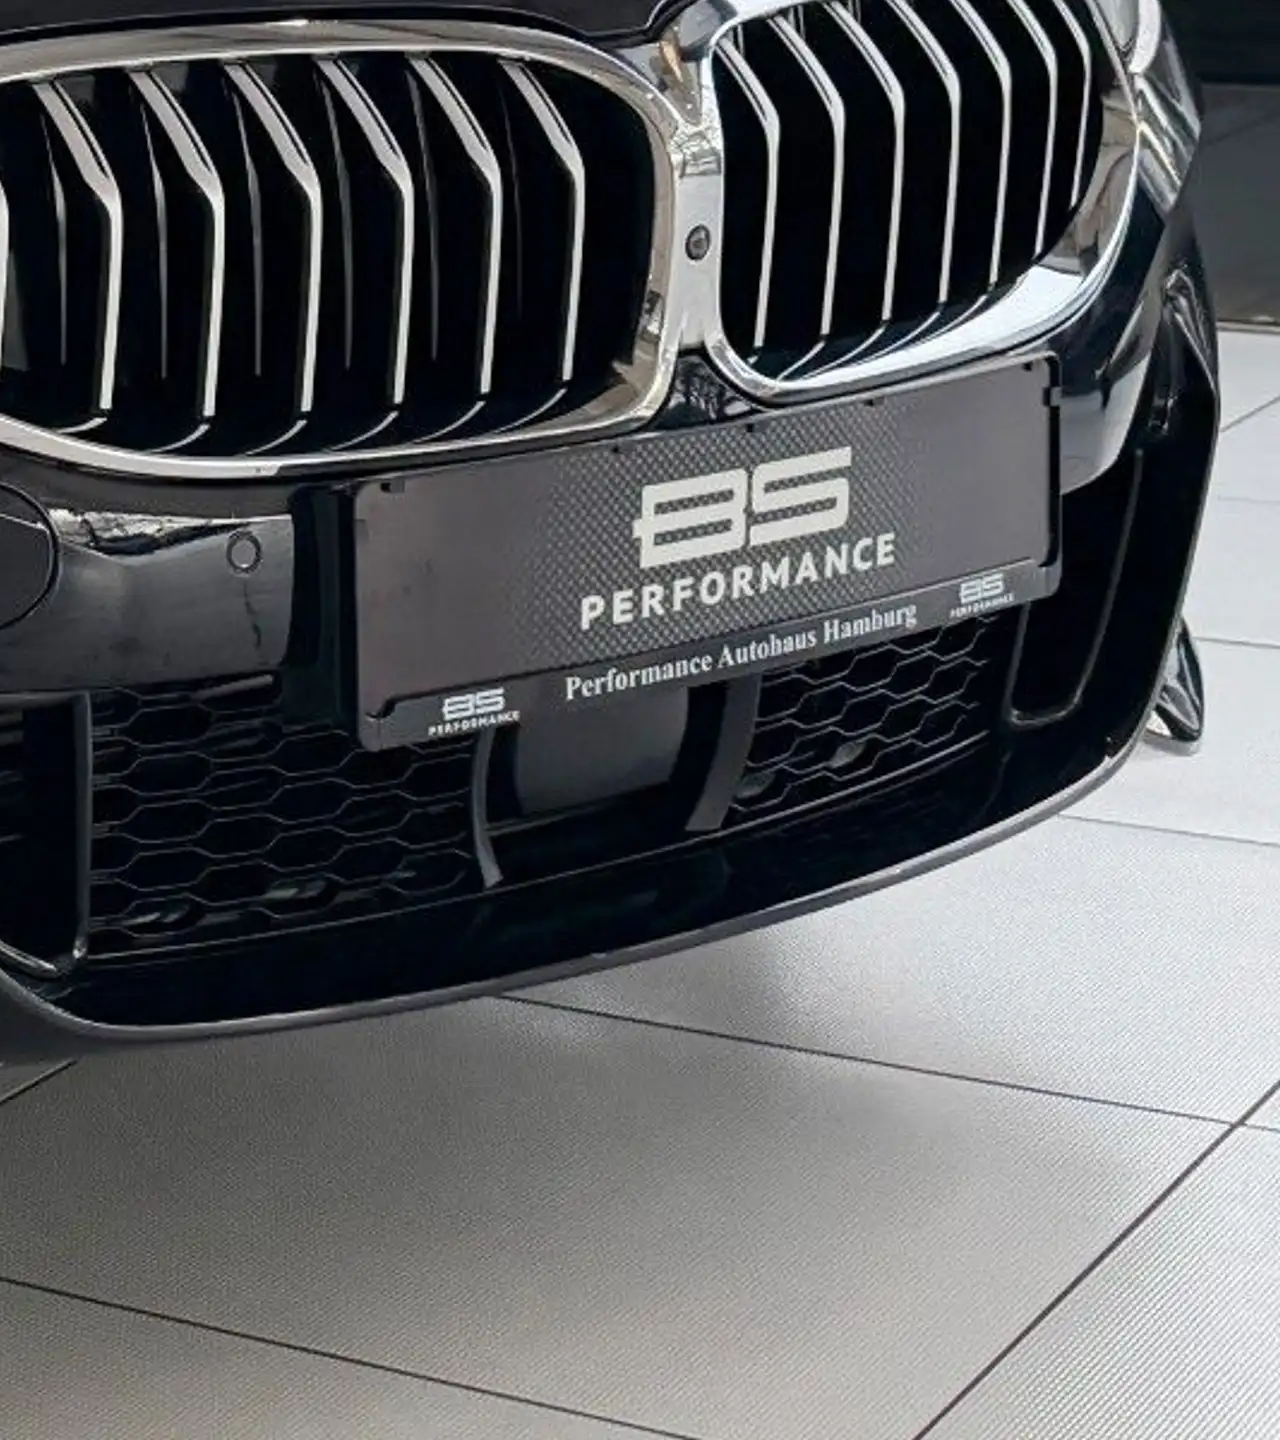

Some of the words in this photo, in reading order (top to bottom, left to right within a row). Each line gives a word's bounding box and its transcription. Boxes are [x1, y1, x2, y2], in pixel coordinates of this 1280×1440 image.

[579, 532, 896, 630] PERFORMANCE
[564, 653, 713, 701] Performance
[716, 626, 817, 669] Autohaus
[822, 603, 918, 643] Hamburg
[427, 710, 520, 736] PERFORMANCE
